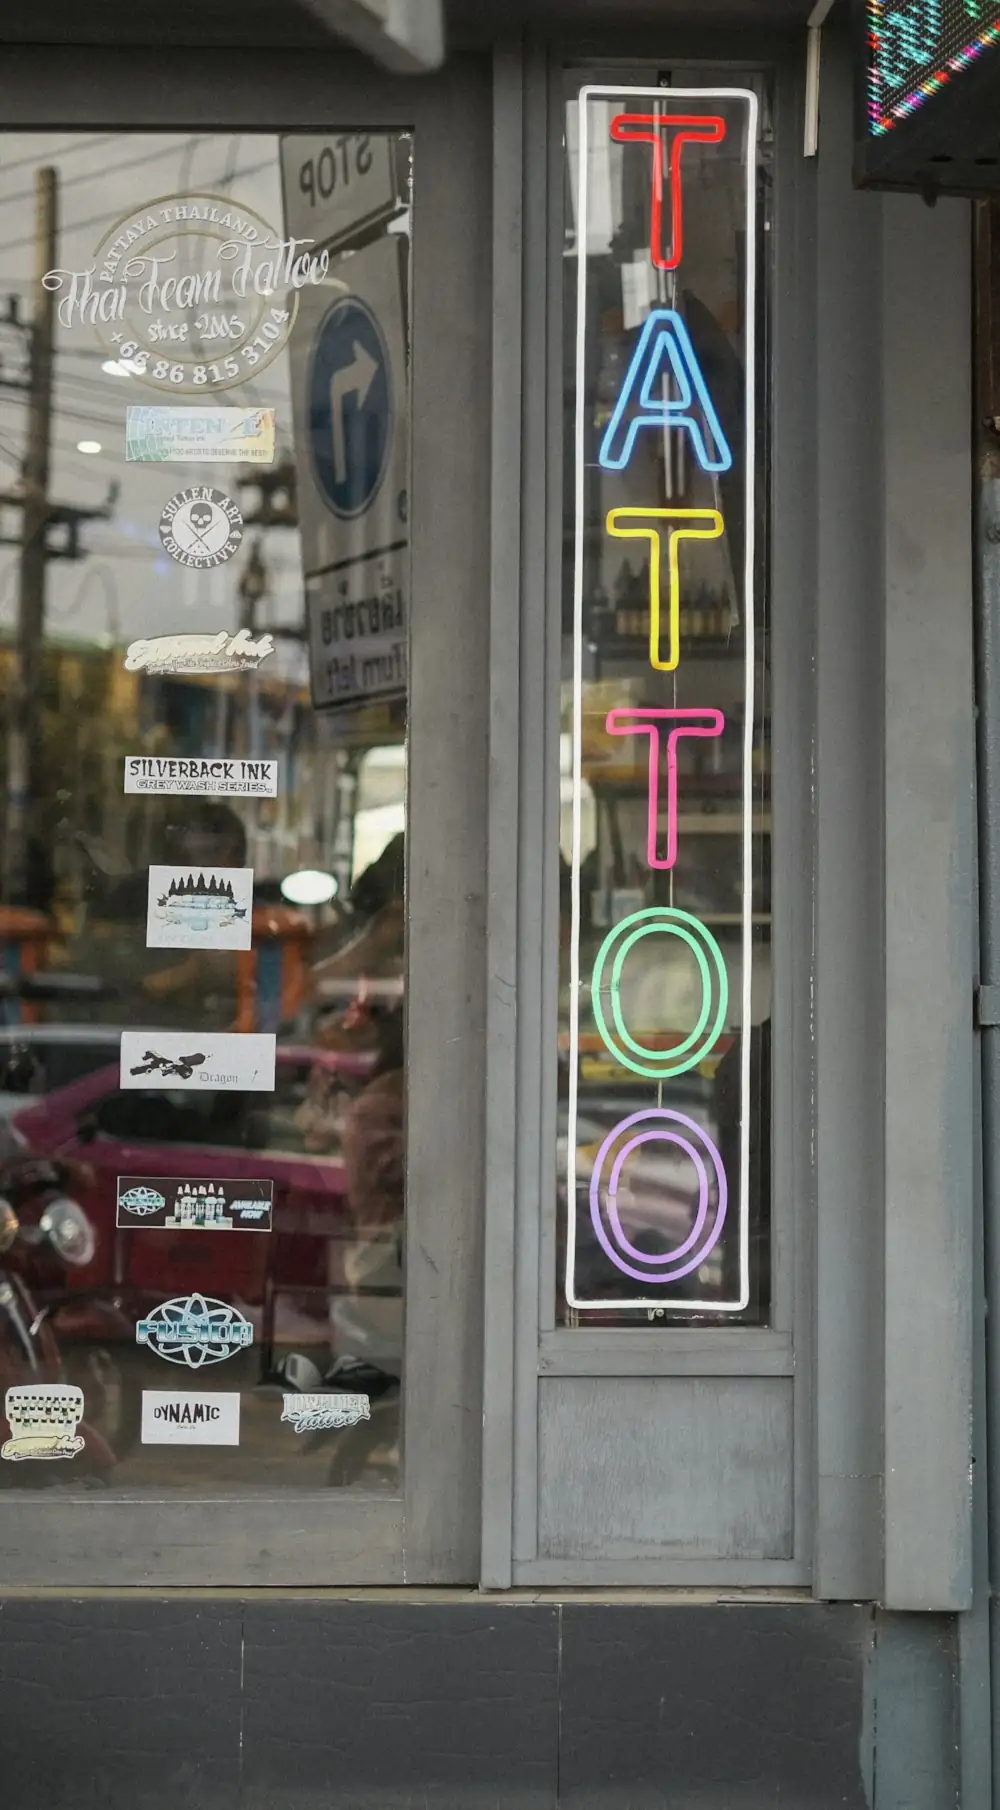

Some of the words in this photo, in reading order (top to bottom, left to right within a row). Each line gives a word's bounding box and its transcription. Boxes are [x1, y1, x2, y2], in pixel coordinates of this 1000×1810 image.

[100, 215, 161, 283] PATTAYA
[160, 205, 258, 241] THAILAND
[42, 262, 128, 329] Thai
[124, 250, 221, 315] Team
[148, 317, 189, 343] since
[195, 313, 246, 340] 2005
[152, 360, 185, 384] 86
[192, 356, 240, 385] 815
[241, 307, 290, 366] 3104
[162, 486, 214, 522] SULLEN
[217, 497, 243, 525] ART
[162, 535, 238, 569] COLLECTIVE
[590, 114, 733, 1284] TATTOO
[129, 759, 235, 780] SILVERBACK
[241, 762, 273, 781] INK
[136, 778, 174, 790] GREY
[175, 780, 216, 791] WASH
[198, 1071, 238, 1085] Dragon
[153, 1402, 221, 1424] DYNAMIC
